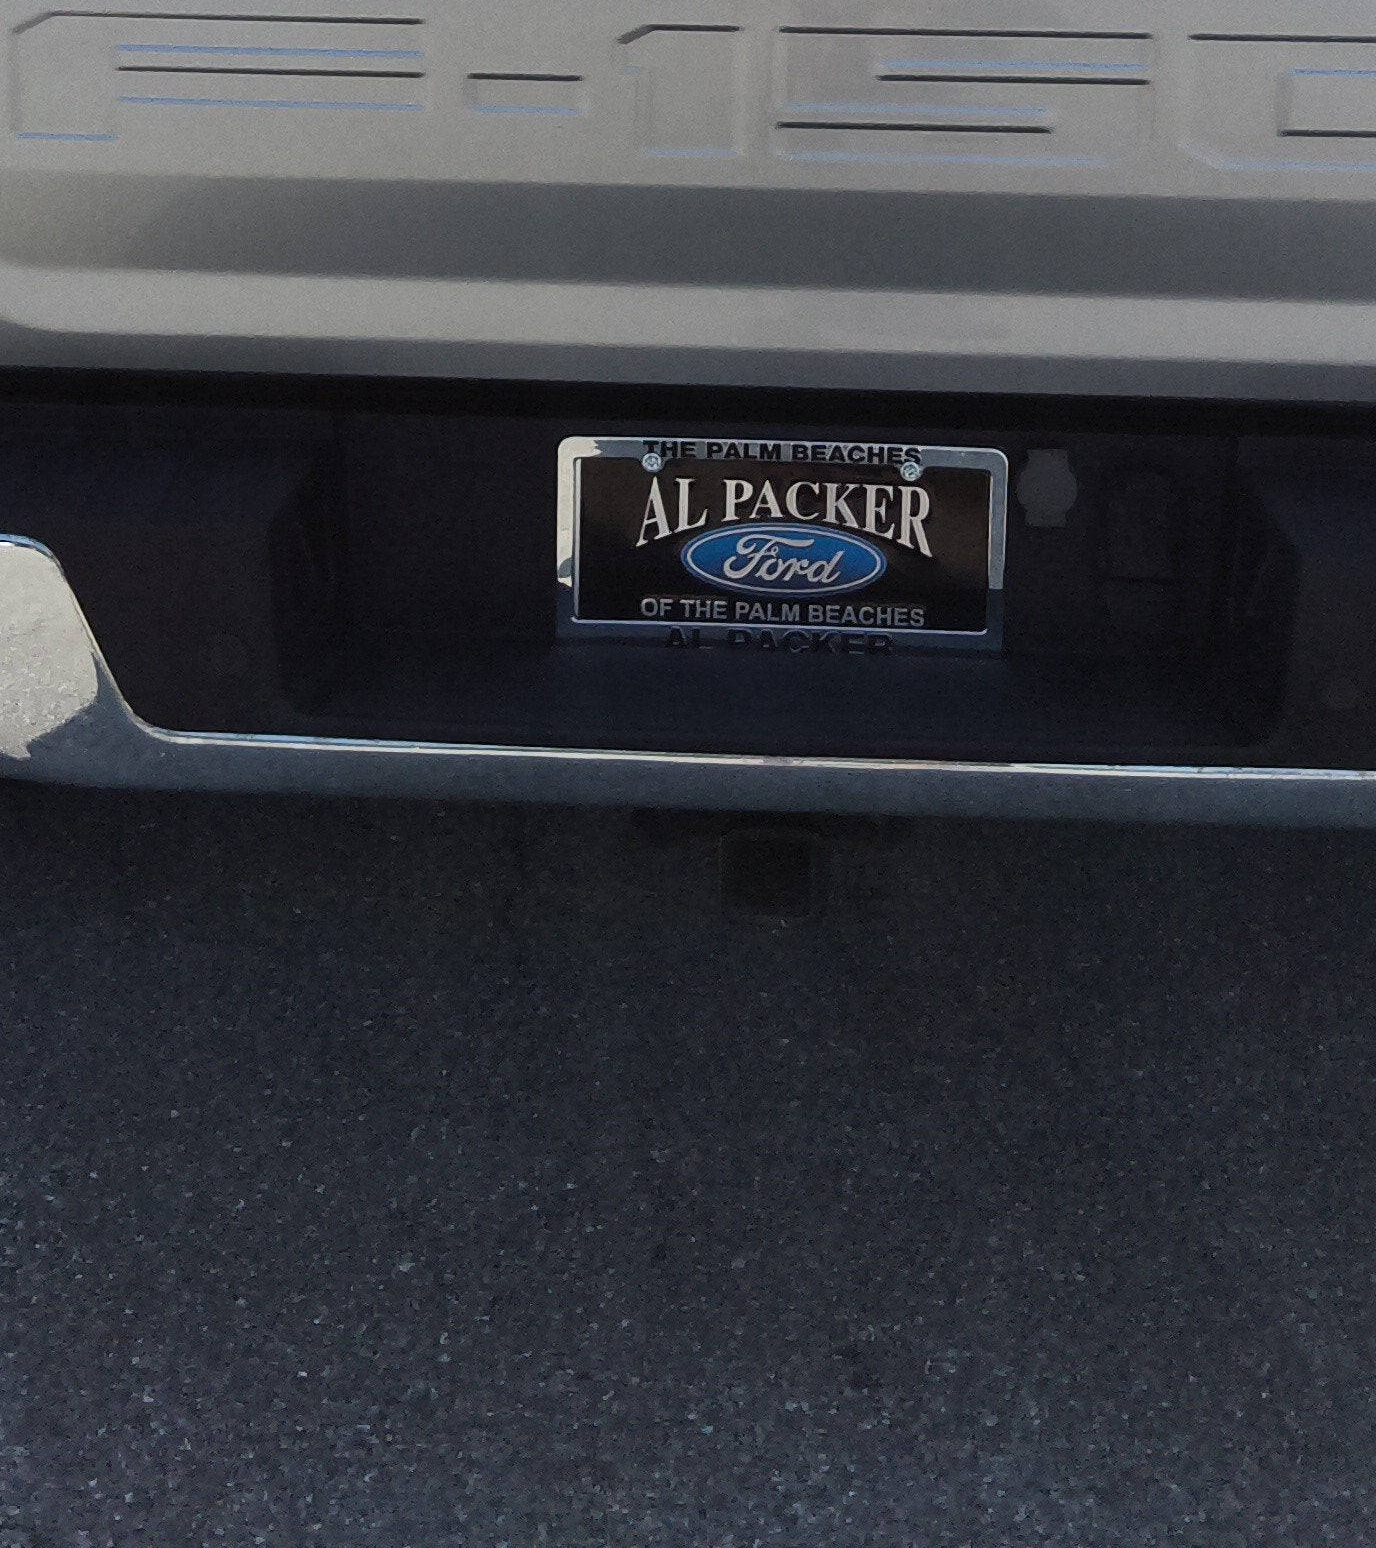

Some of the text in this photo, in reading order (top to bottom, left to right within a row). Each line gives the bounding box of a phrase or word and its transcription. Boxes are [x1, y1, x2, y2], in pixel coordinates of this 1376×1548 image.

[642, 439, 923, 465] THE PALM BEACHES
[635, 476, 933, 559] AL PACKER
[723, 534, 841, 584] Ford
[640, 596, 926, 627] OF THE PALM BEACHES
